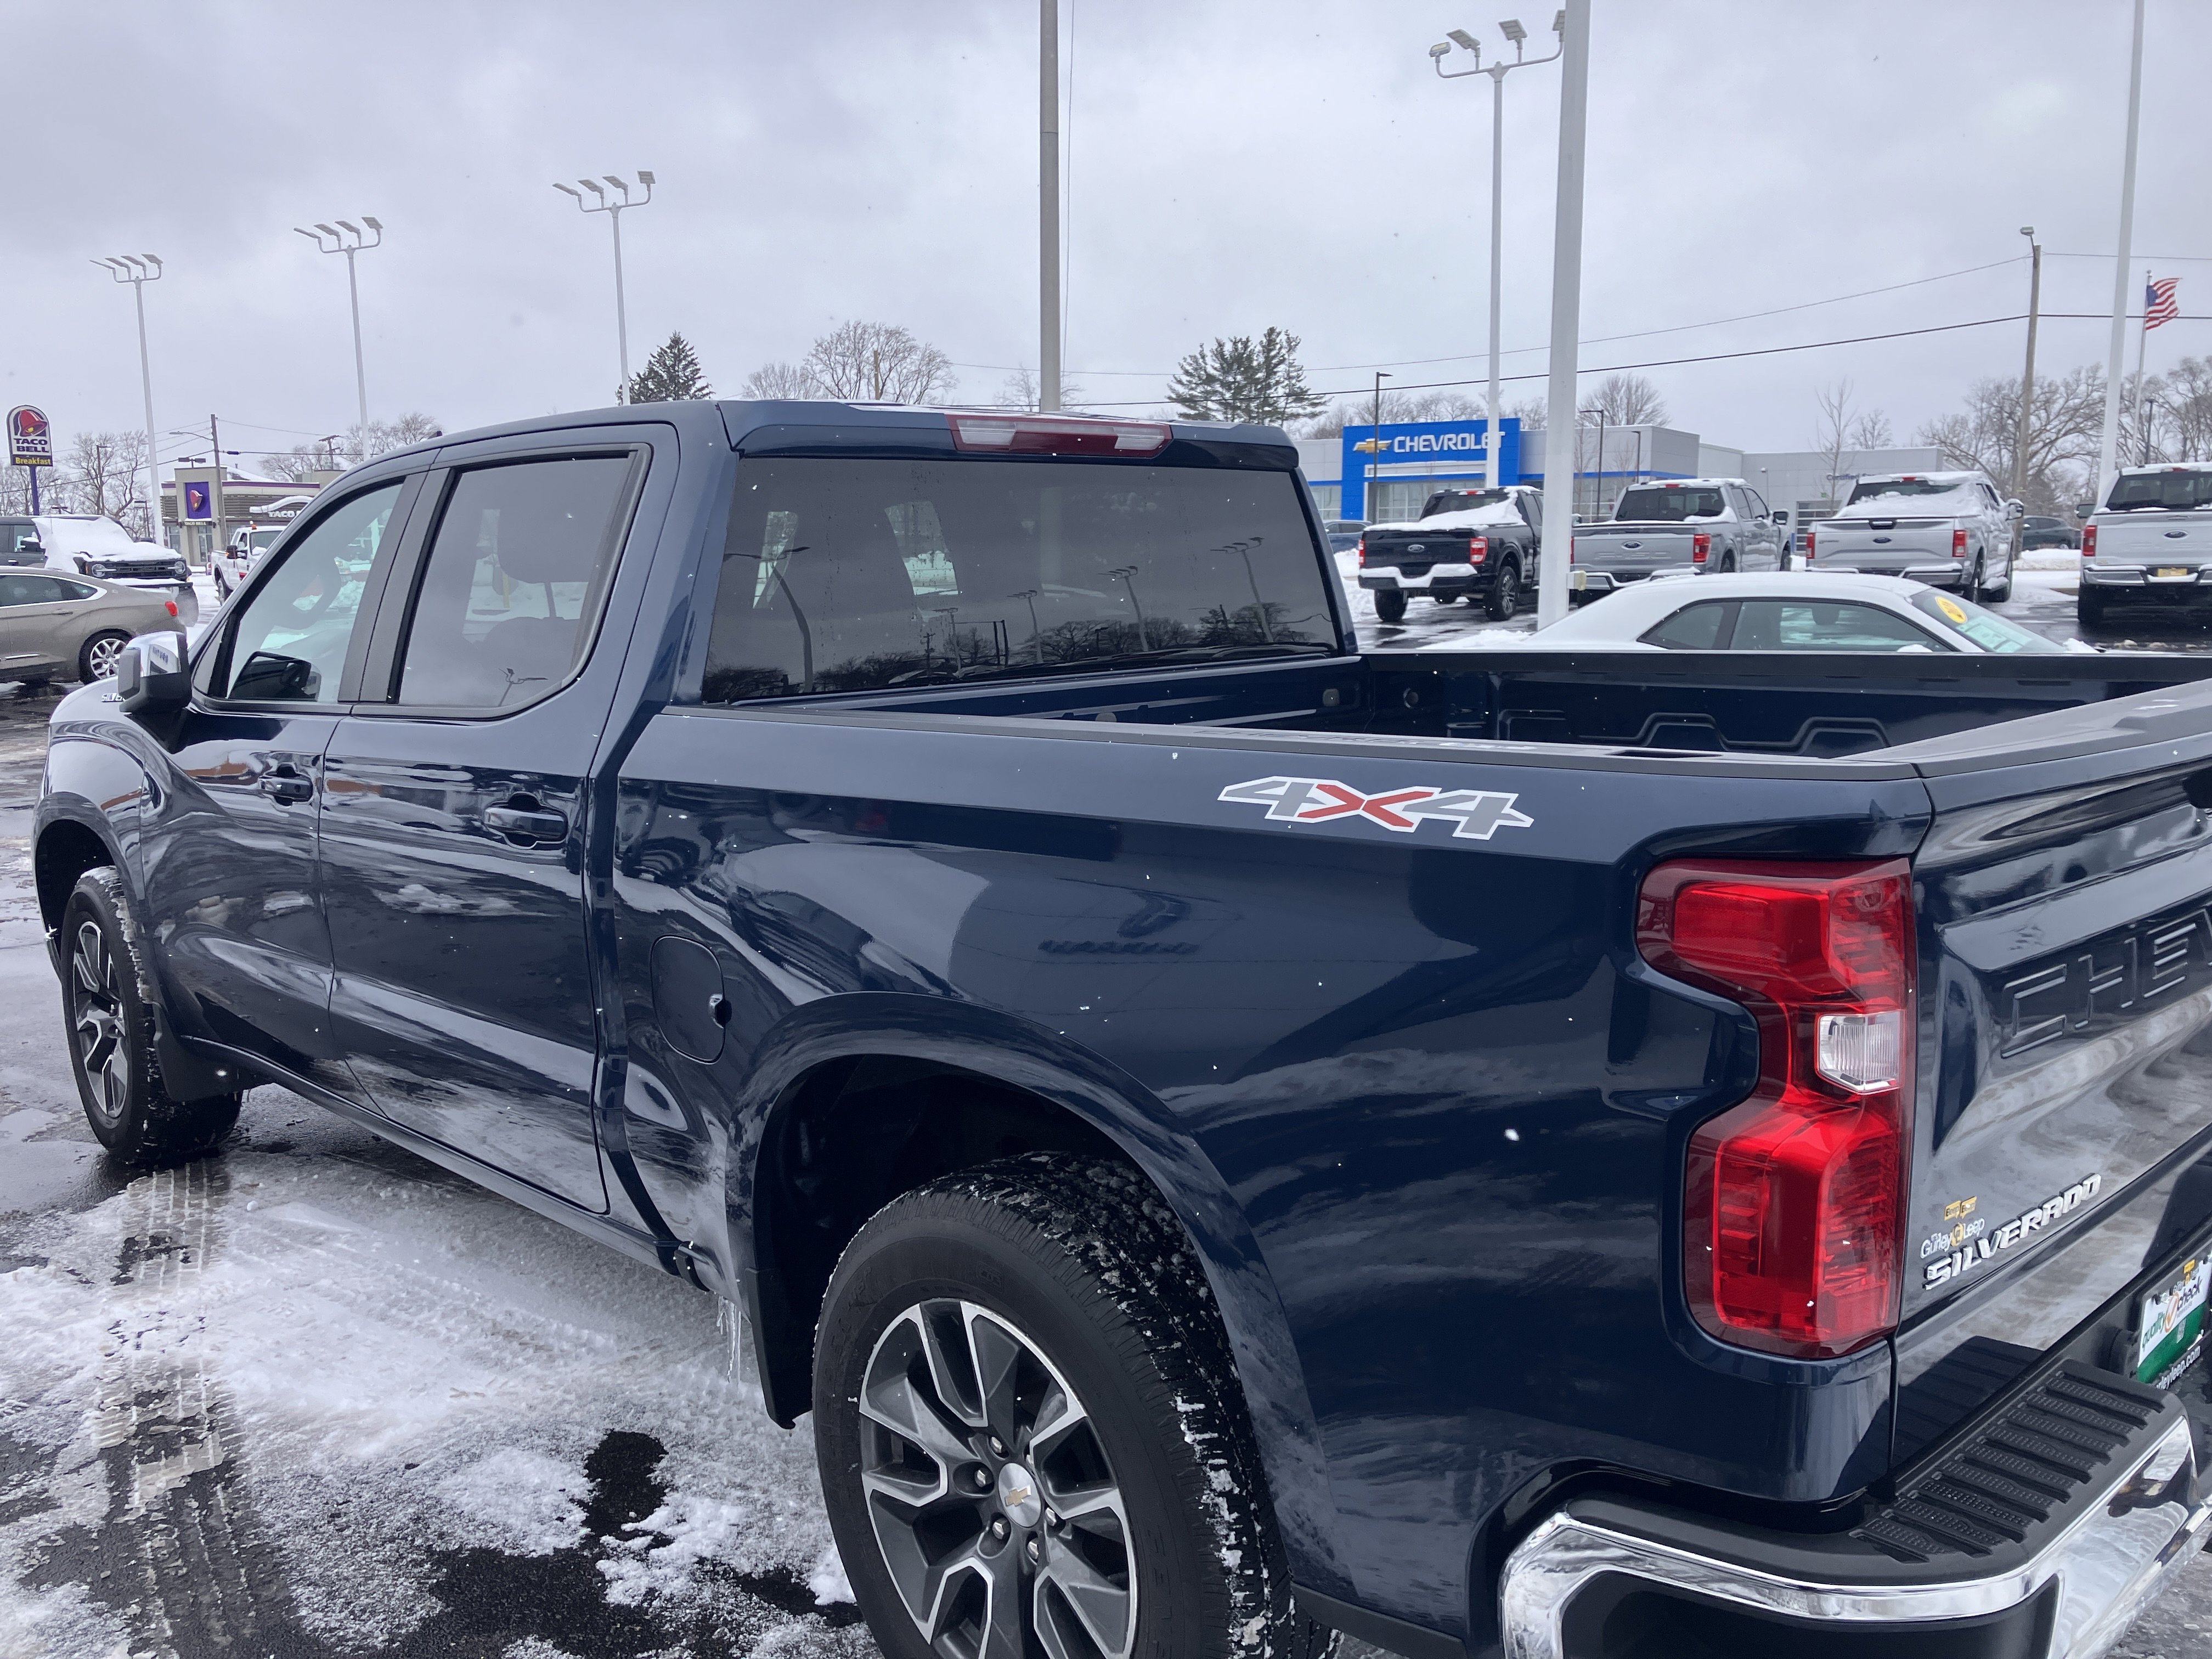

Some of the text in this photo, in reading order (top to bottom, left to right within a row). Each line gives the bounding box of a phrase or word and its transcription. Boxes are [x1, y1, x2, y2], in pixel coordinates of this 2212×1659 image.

[15, 457, 51, 465] Breakfast
[1922, 1172, 2102, 1290] SILVERADO
[1963, 1218, 1985, 1239] Leep
